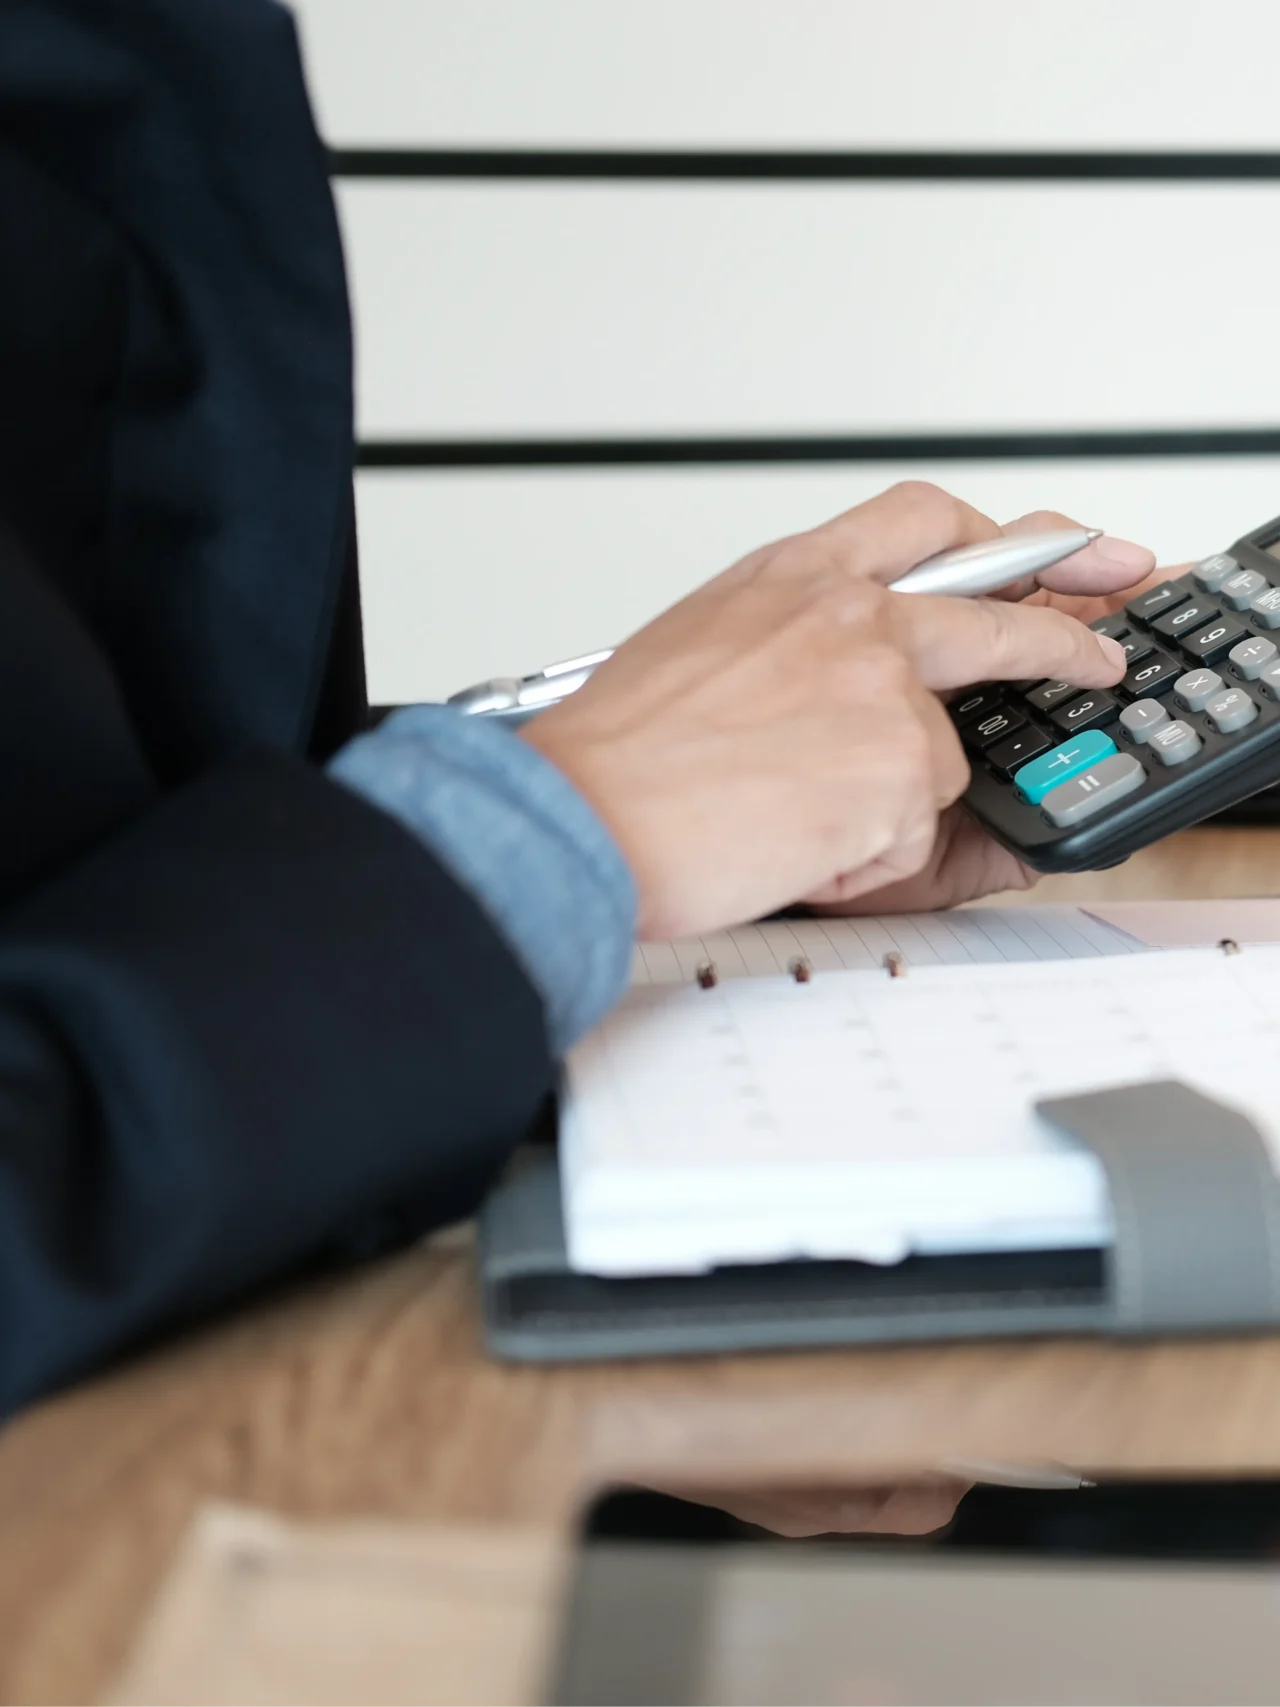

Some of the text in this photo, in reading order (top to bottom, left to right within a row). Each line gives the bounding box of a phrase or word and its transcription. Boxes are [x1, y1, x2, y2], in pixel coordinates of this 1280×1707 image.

[1144, 588, 1172, 606] 7
[1172, 607, 1199, 625] 8
[1199, 627, 1226, 644] 9
[1134, 665, 1162, 681] 6
[1043, 683, 1069, 698] 2
[959, 696, 984, 712] 0
[1068, 701, 1094, 718] 3
[1214, 694, 1240, 712] %
[977, 715, 1009, 736] 00
[1154, 724, 1187, 746] MU
